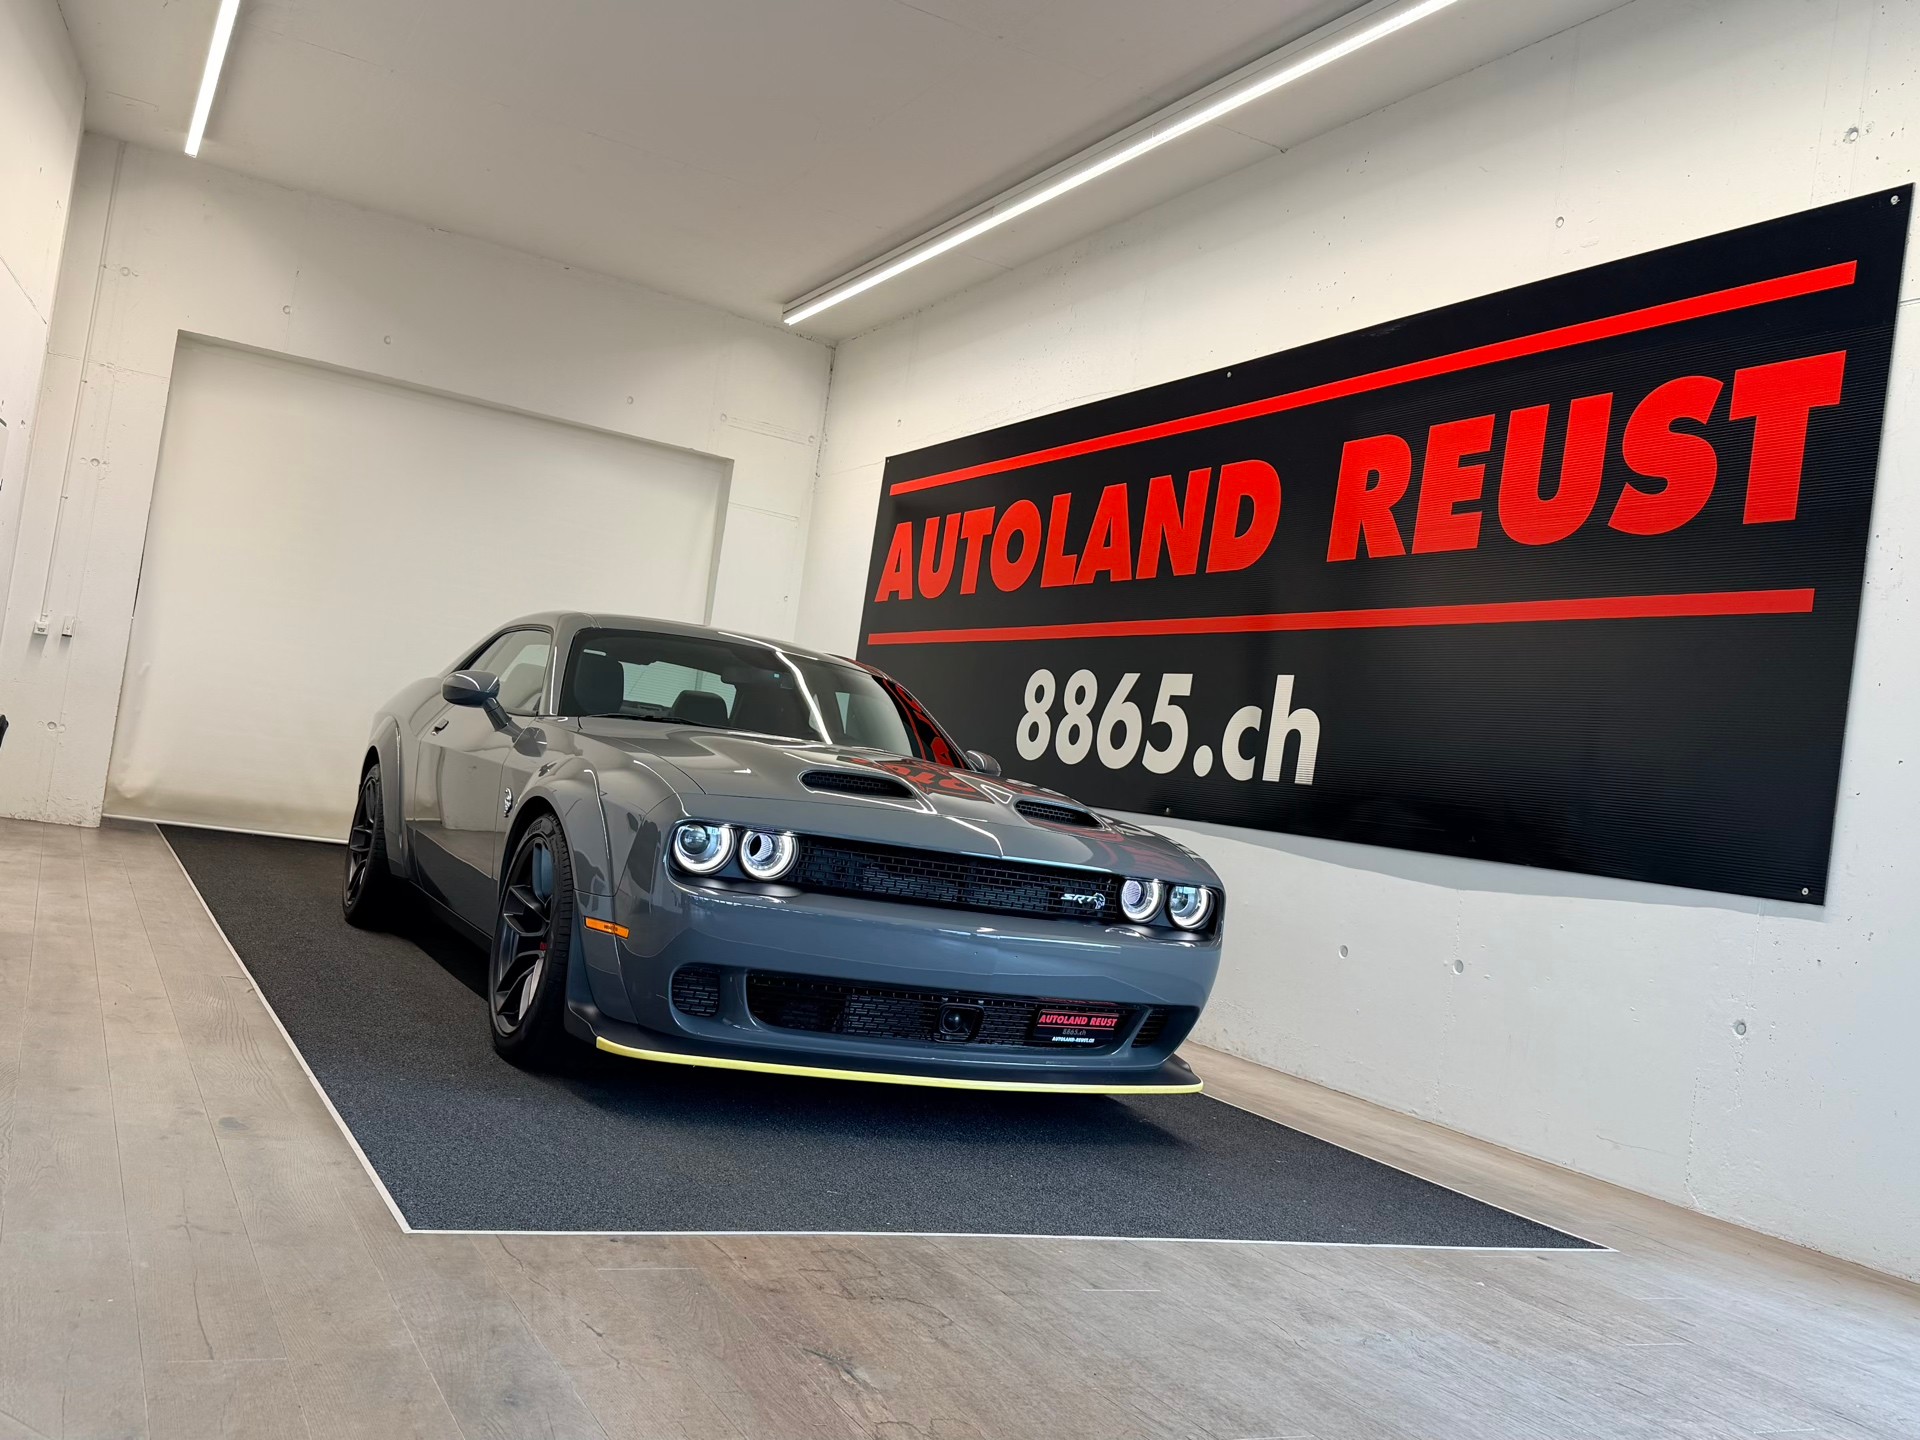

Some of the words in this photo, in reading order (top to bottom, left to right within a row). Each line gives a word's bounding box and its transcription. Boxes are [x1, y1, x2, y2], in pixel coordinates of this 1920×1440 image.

[874, 460, 1282, 602] AUTOLAND
[1326, 350, 1847, 563] REUST
[1015, 668, 1321, 786] 8865.ch
[1061, 893, 1097, 904] SRT
[1039, 1014, 1088, 1025] AUTOLAND
[1089, 1017, 1118, 1027] REUST
